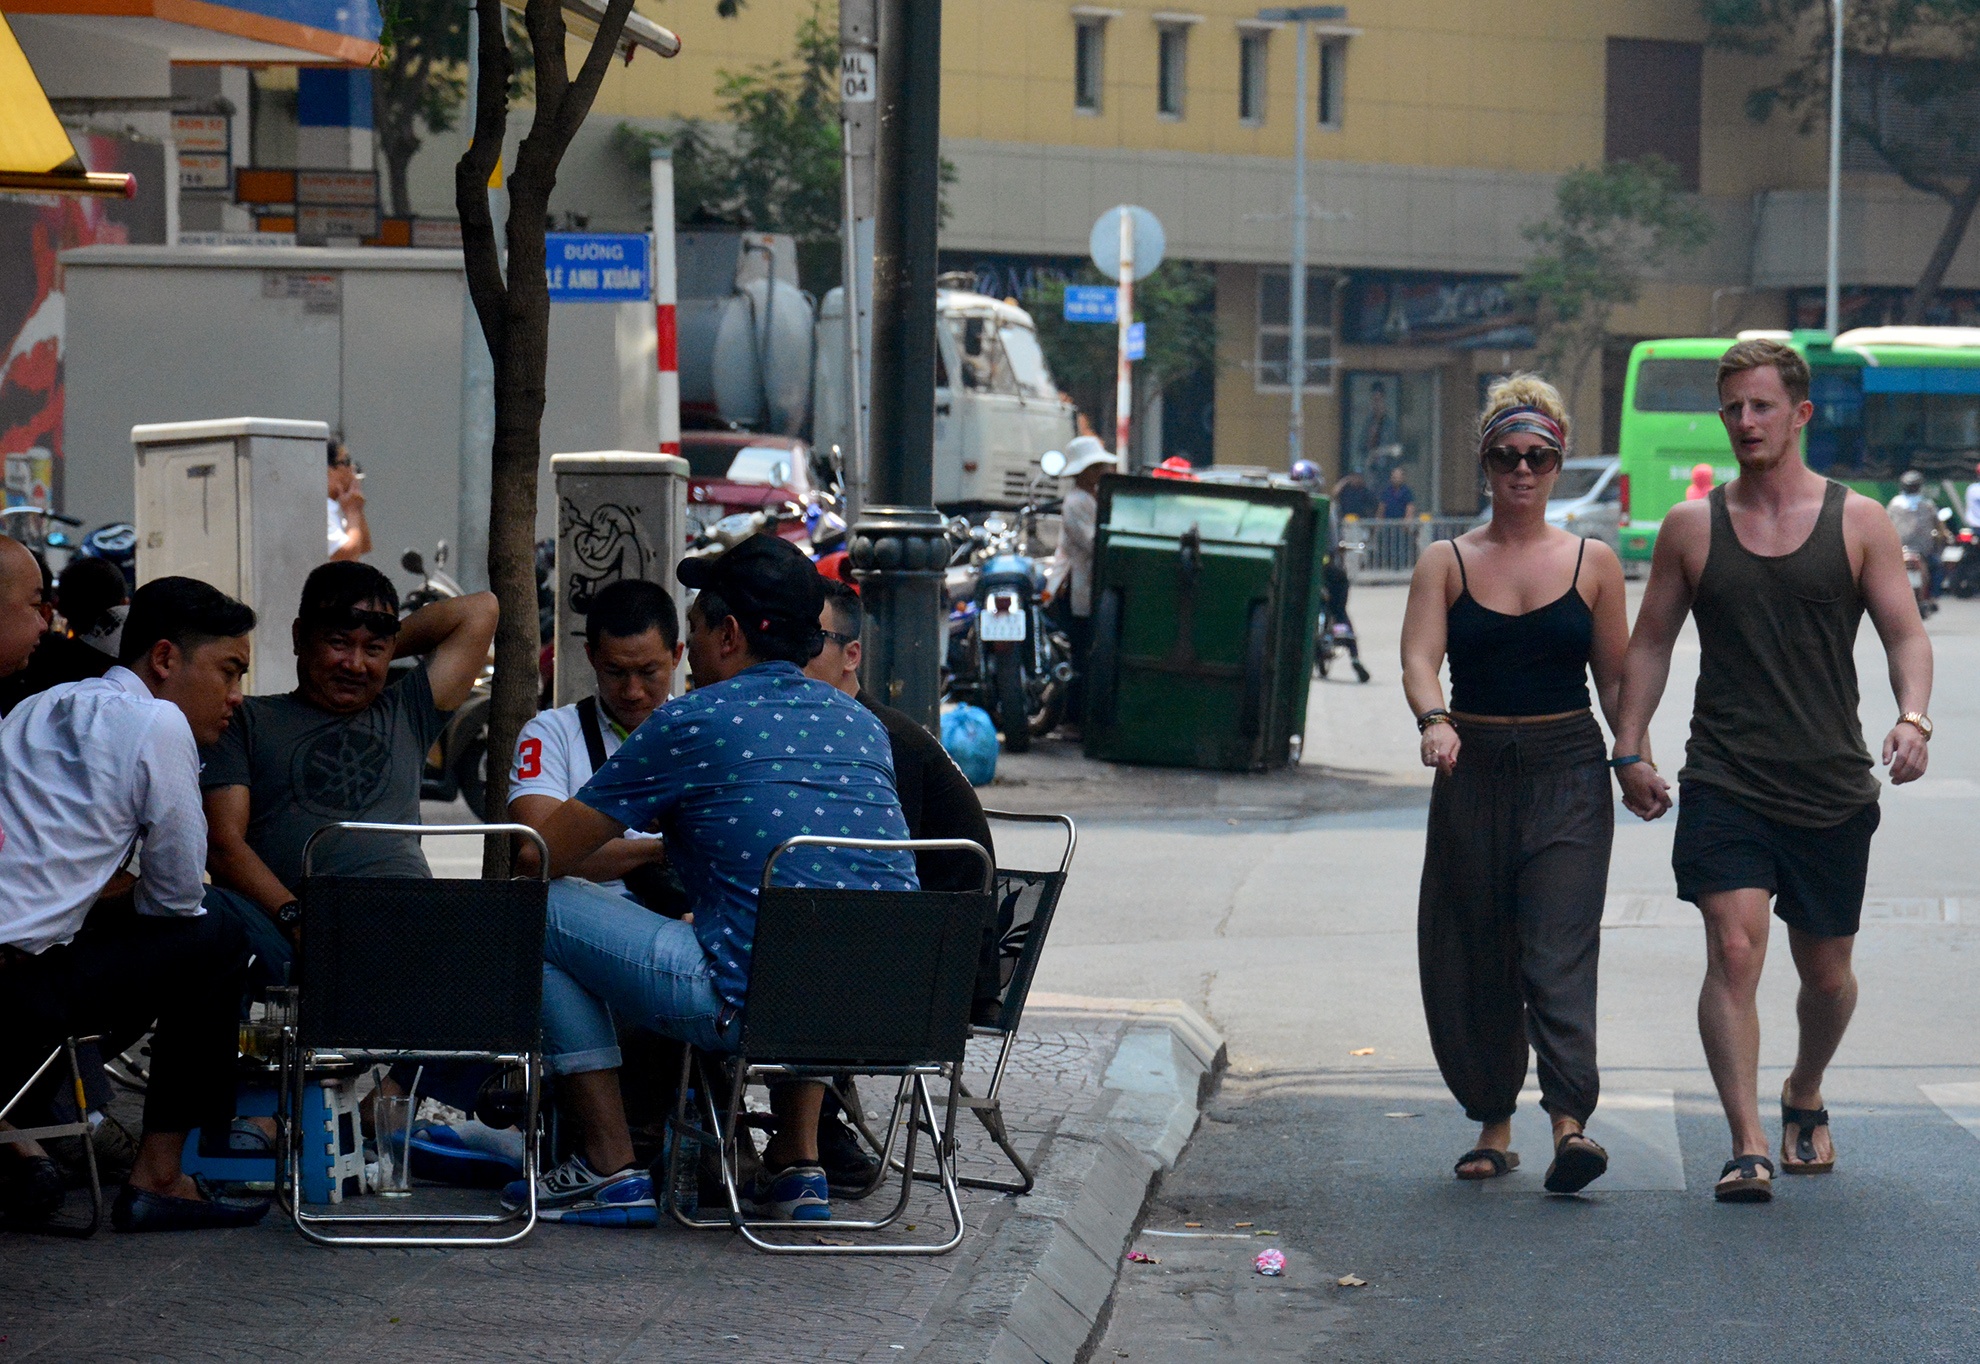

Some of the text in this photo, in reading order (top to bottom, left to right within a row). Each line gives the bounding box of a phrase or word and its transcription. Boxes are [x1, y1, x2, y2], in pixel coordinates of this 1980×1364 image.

[843, 57, 867, 73] ML
[846, 78, 867, 96] 04
[568, 269, 599, 289] ANH
[602, 264, 641, 290] XUÂN
[517, 737, 542, 781] 3
